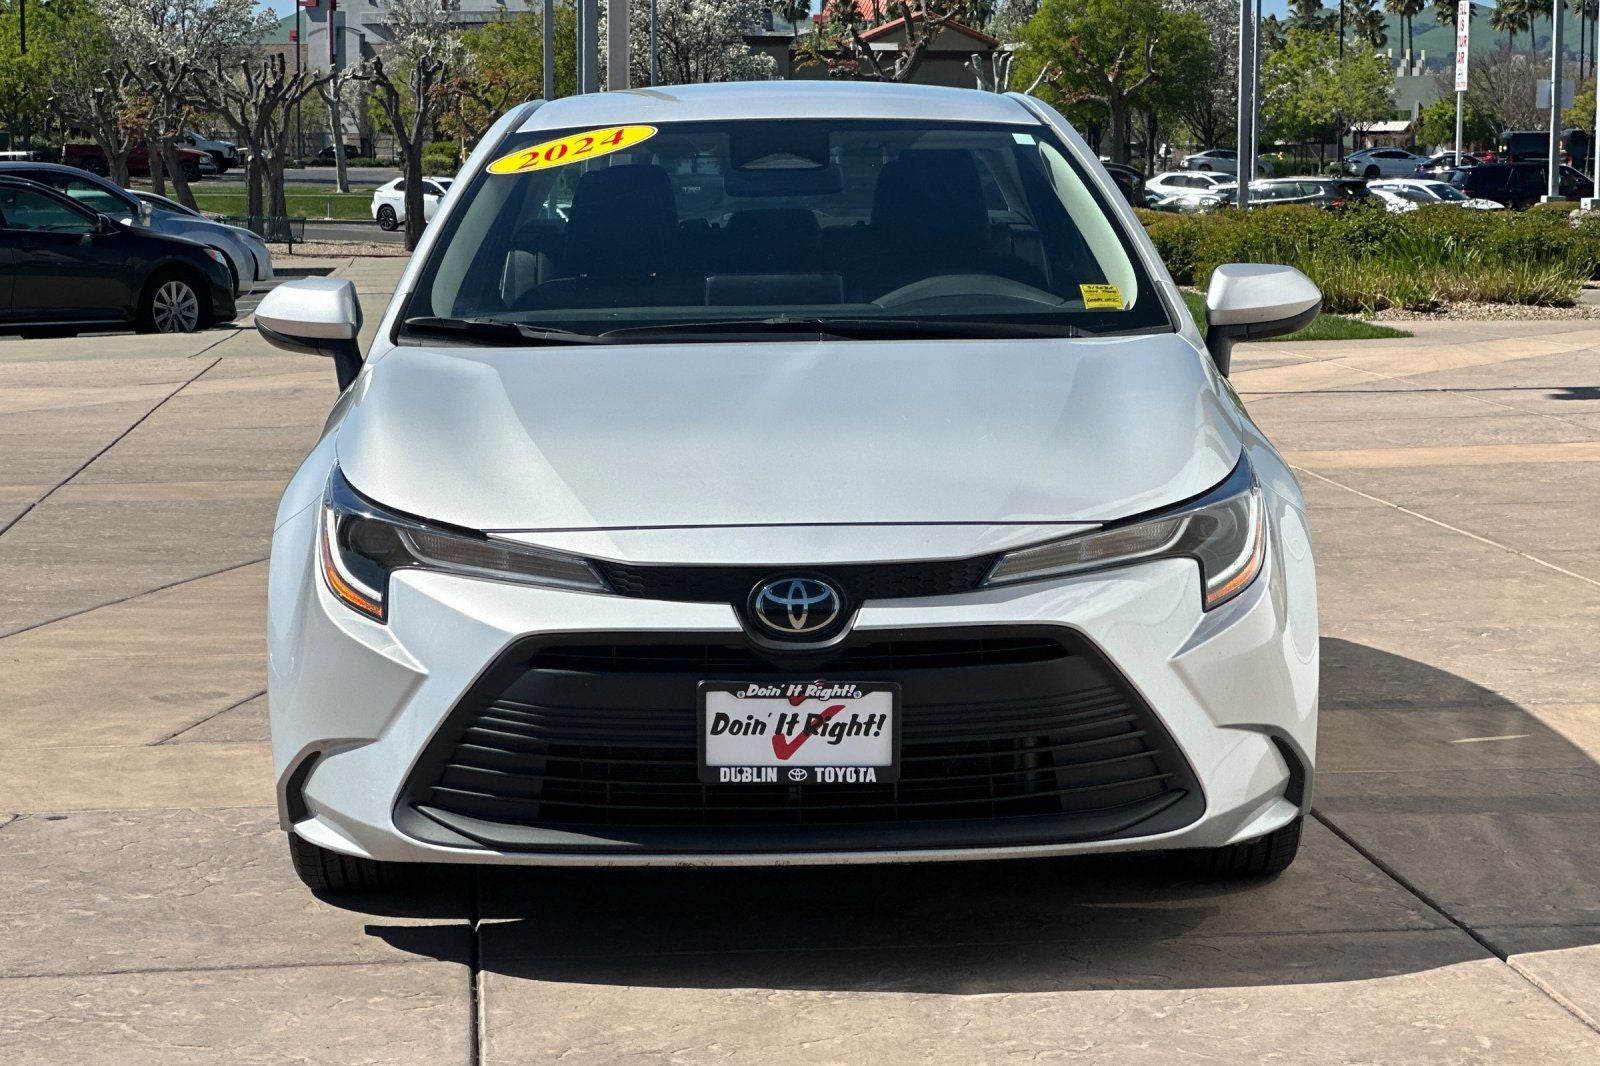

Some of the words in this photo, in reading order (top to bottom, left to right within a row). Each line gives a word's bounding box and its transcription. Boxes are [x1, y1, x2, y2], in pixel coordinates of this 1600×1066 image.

[517, 128, 625, 170] 2024
[746, 684, 784, 697] Doin'
[786, 684, 803, 697] It
[805, 683, 857, 701] Right!
[710, 712, 773, 736] Doin'
[774, 713, 799, 737] It
[802, 713, 887, 745] Right!
[720, 767, 778, 783] DUBLIN
[814, 767, 877, 783] TOYOTA
